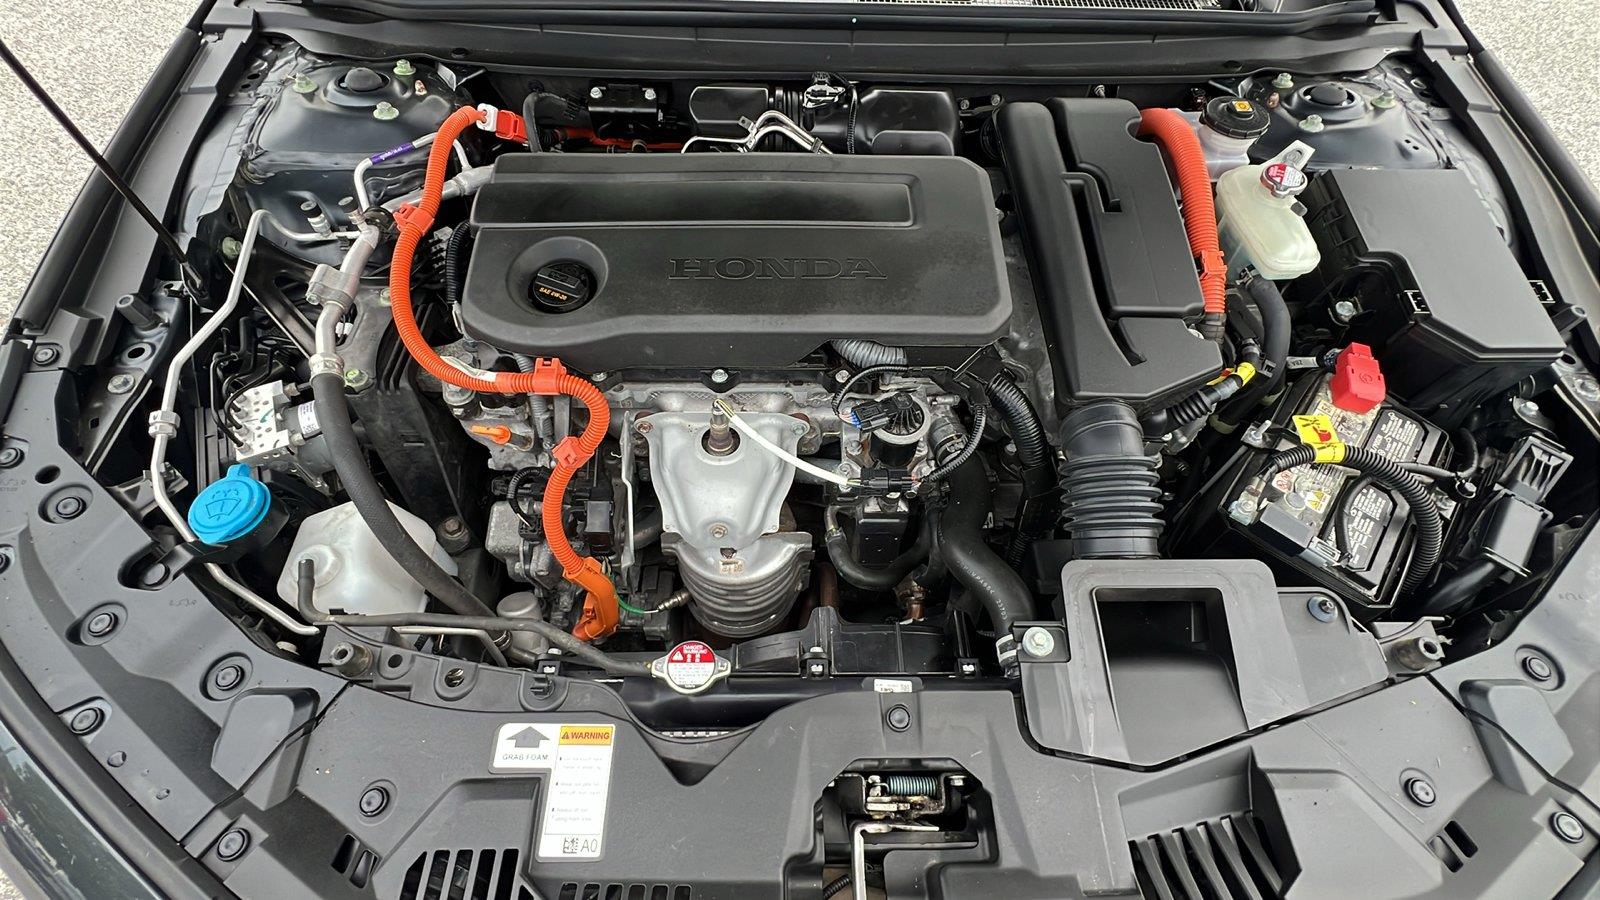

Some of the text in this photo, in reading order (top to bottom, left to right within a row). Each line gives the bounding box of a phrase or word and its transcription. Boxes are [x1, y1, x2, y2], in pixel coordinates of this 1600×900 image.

[669, 257, 888, 280] HONDA
[539, 287, 551, 295] SAE
[571, 732, 610, 740] WARNING
